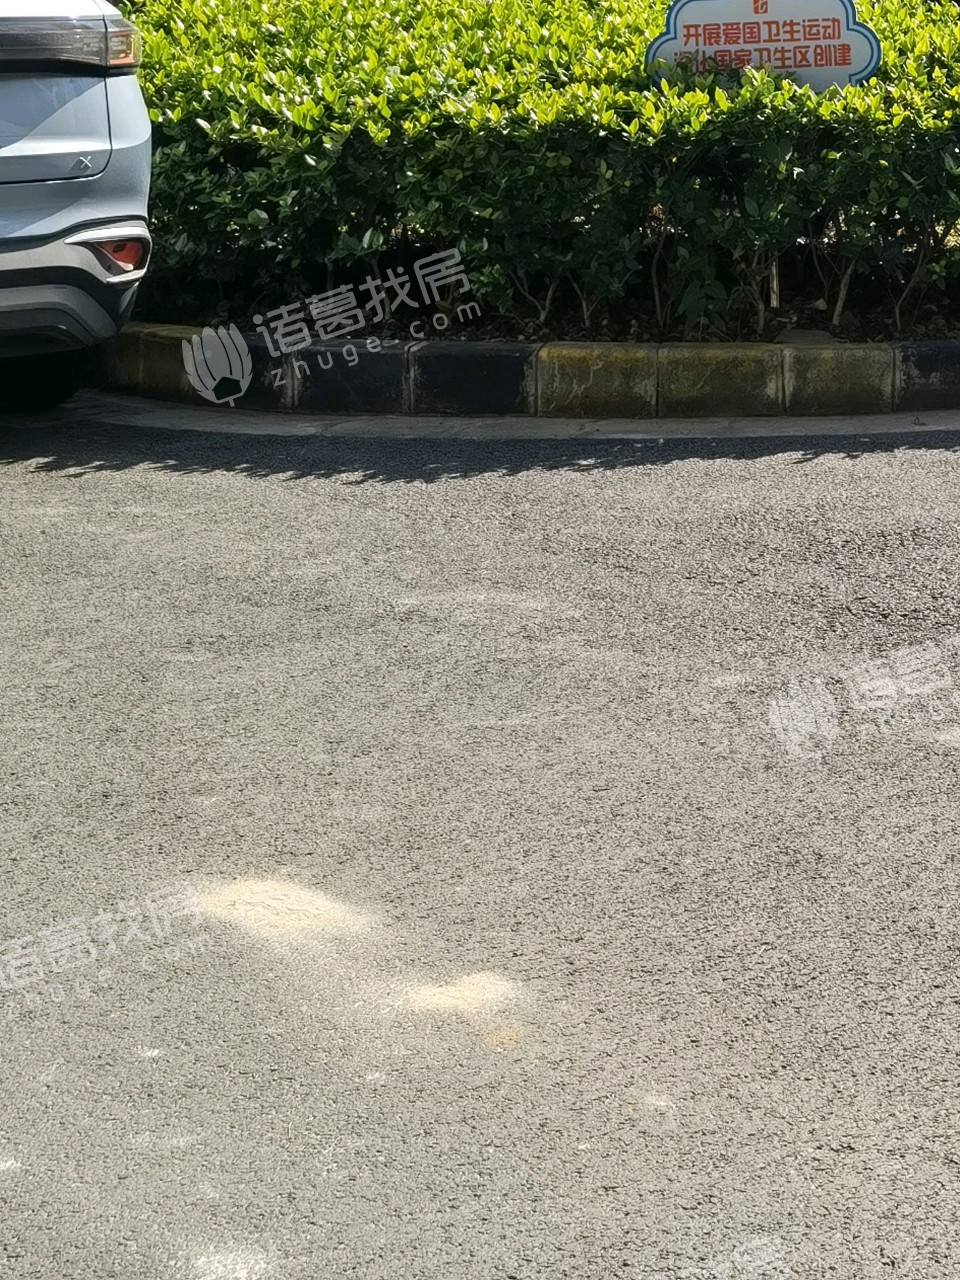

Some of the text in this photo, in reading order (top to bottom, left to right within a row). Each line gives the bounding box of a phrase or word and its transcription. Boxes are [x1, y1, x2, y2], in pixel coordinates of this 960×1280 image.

[682, 17, 841, 47] 开展爱国卫生运动
